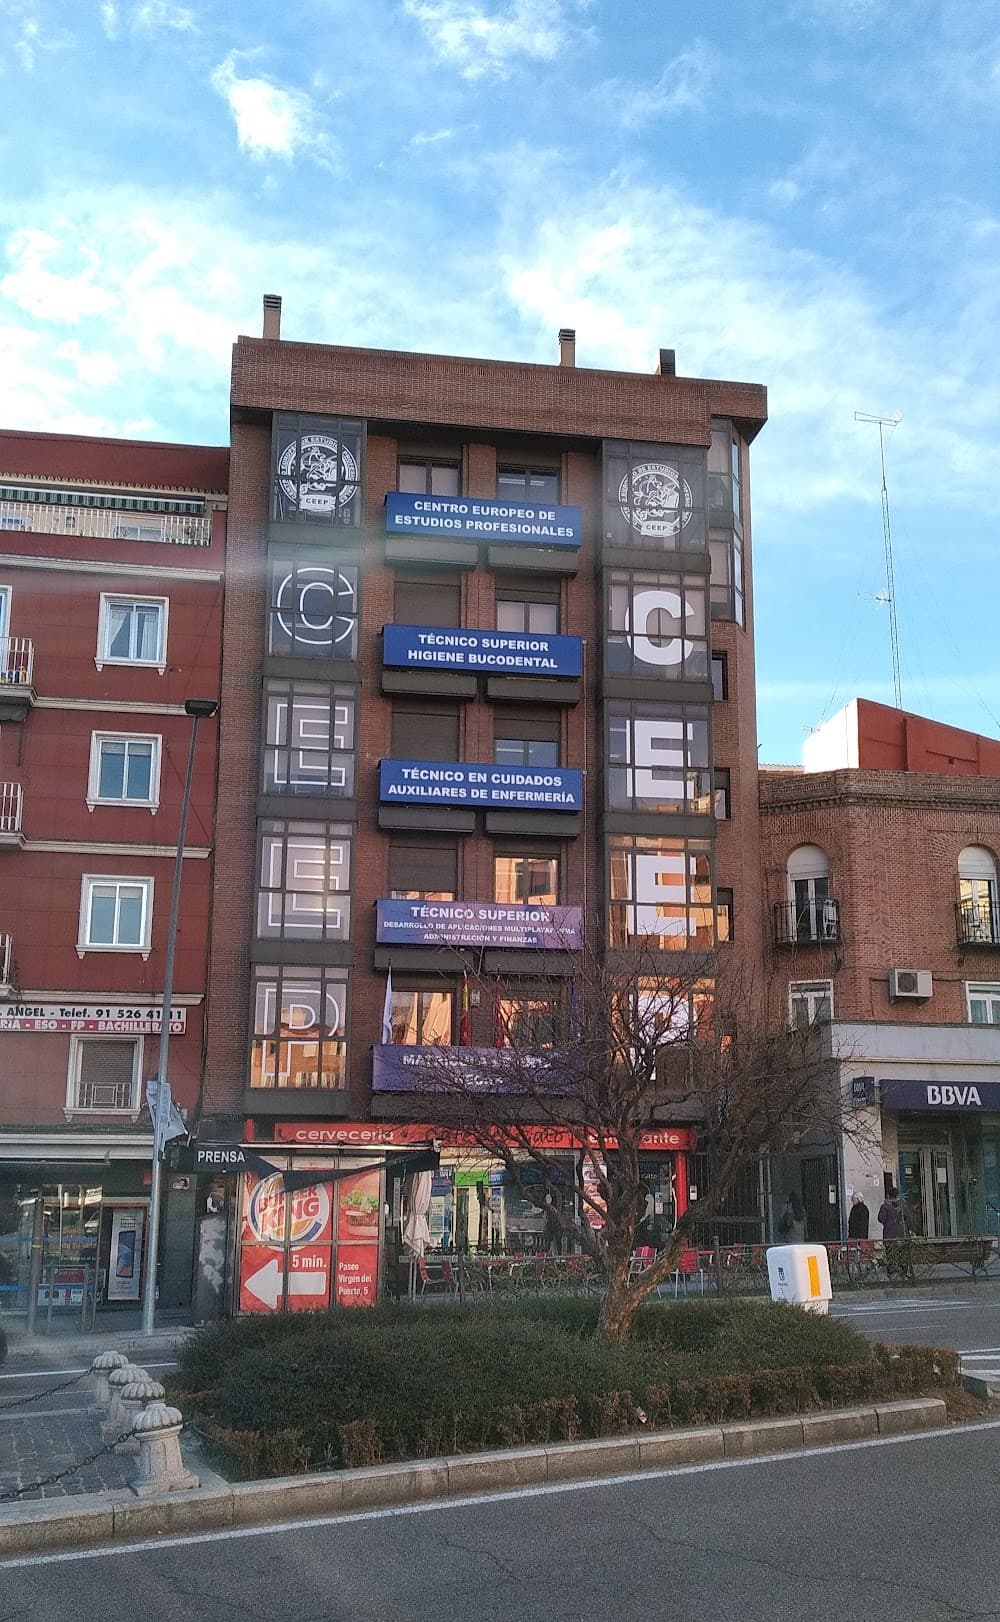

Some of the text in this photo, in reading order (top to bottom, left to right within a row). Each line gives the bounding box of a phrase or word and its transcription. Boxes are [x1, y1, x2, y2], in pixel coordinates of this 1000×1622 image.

[414, 501, 556, 521] CENTRO EUROPEO DE
[395, 514, 574, 537] ESTUDIOS PROFESIONALES
[418, 633, 549, 651] TÉCNICO SUPERIOR
[408, 650, 558, 668] HIGIENE BUCODENTAL
[402, 768, 562, 786] TÉCNICO EN CUIDADOS
[388, 785, 575, 803] AUXILIARES DE ENFERMERÍA
[411, 904, 551, 922] TÉCNICO SUPERIOR
[384, 921, 434, 930] DESARROLLO
[448, 923, 502, 932] APLICACIONES
[424, 933, 490, 942] ADMNISTRACIÓN
[60, 1008, 90, 1018] Telef.
[96, 1009, 110, 1018] 91
[117, 1009, 141, 1018] 526
[146, 1010, 161, 1019] 41
[34, 1020, 57, 1029] ESO
[71, 1021, 85, 1030] FP
[927, 1085, 982, 1105] BBVA
[198, 1151, 245, 1163] PRENSA
[259, 1186, 317, 1213] BURER
[262, 1197, 320, 1233] KING
[292, 1255, 327, 1268] 5 min.
[339, 1263, 359, 1271] Paseo
[338, 1274, 372, 1284] Virgen del
[339, 1287, 362, 1296] Puerto,
